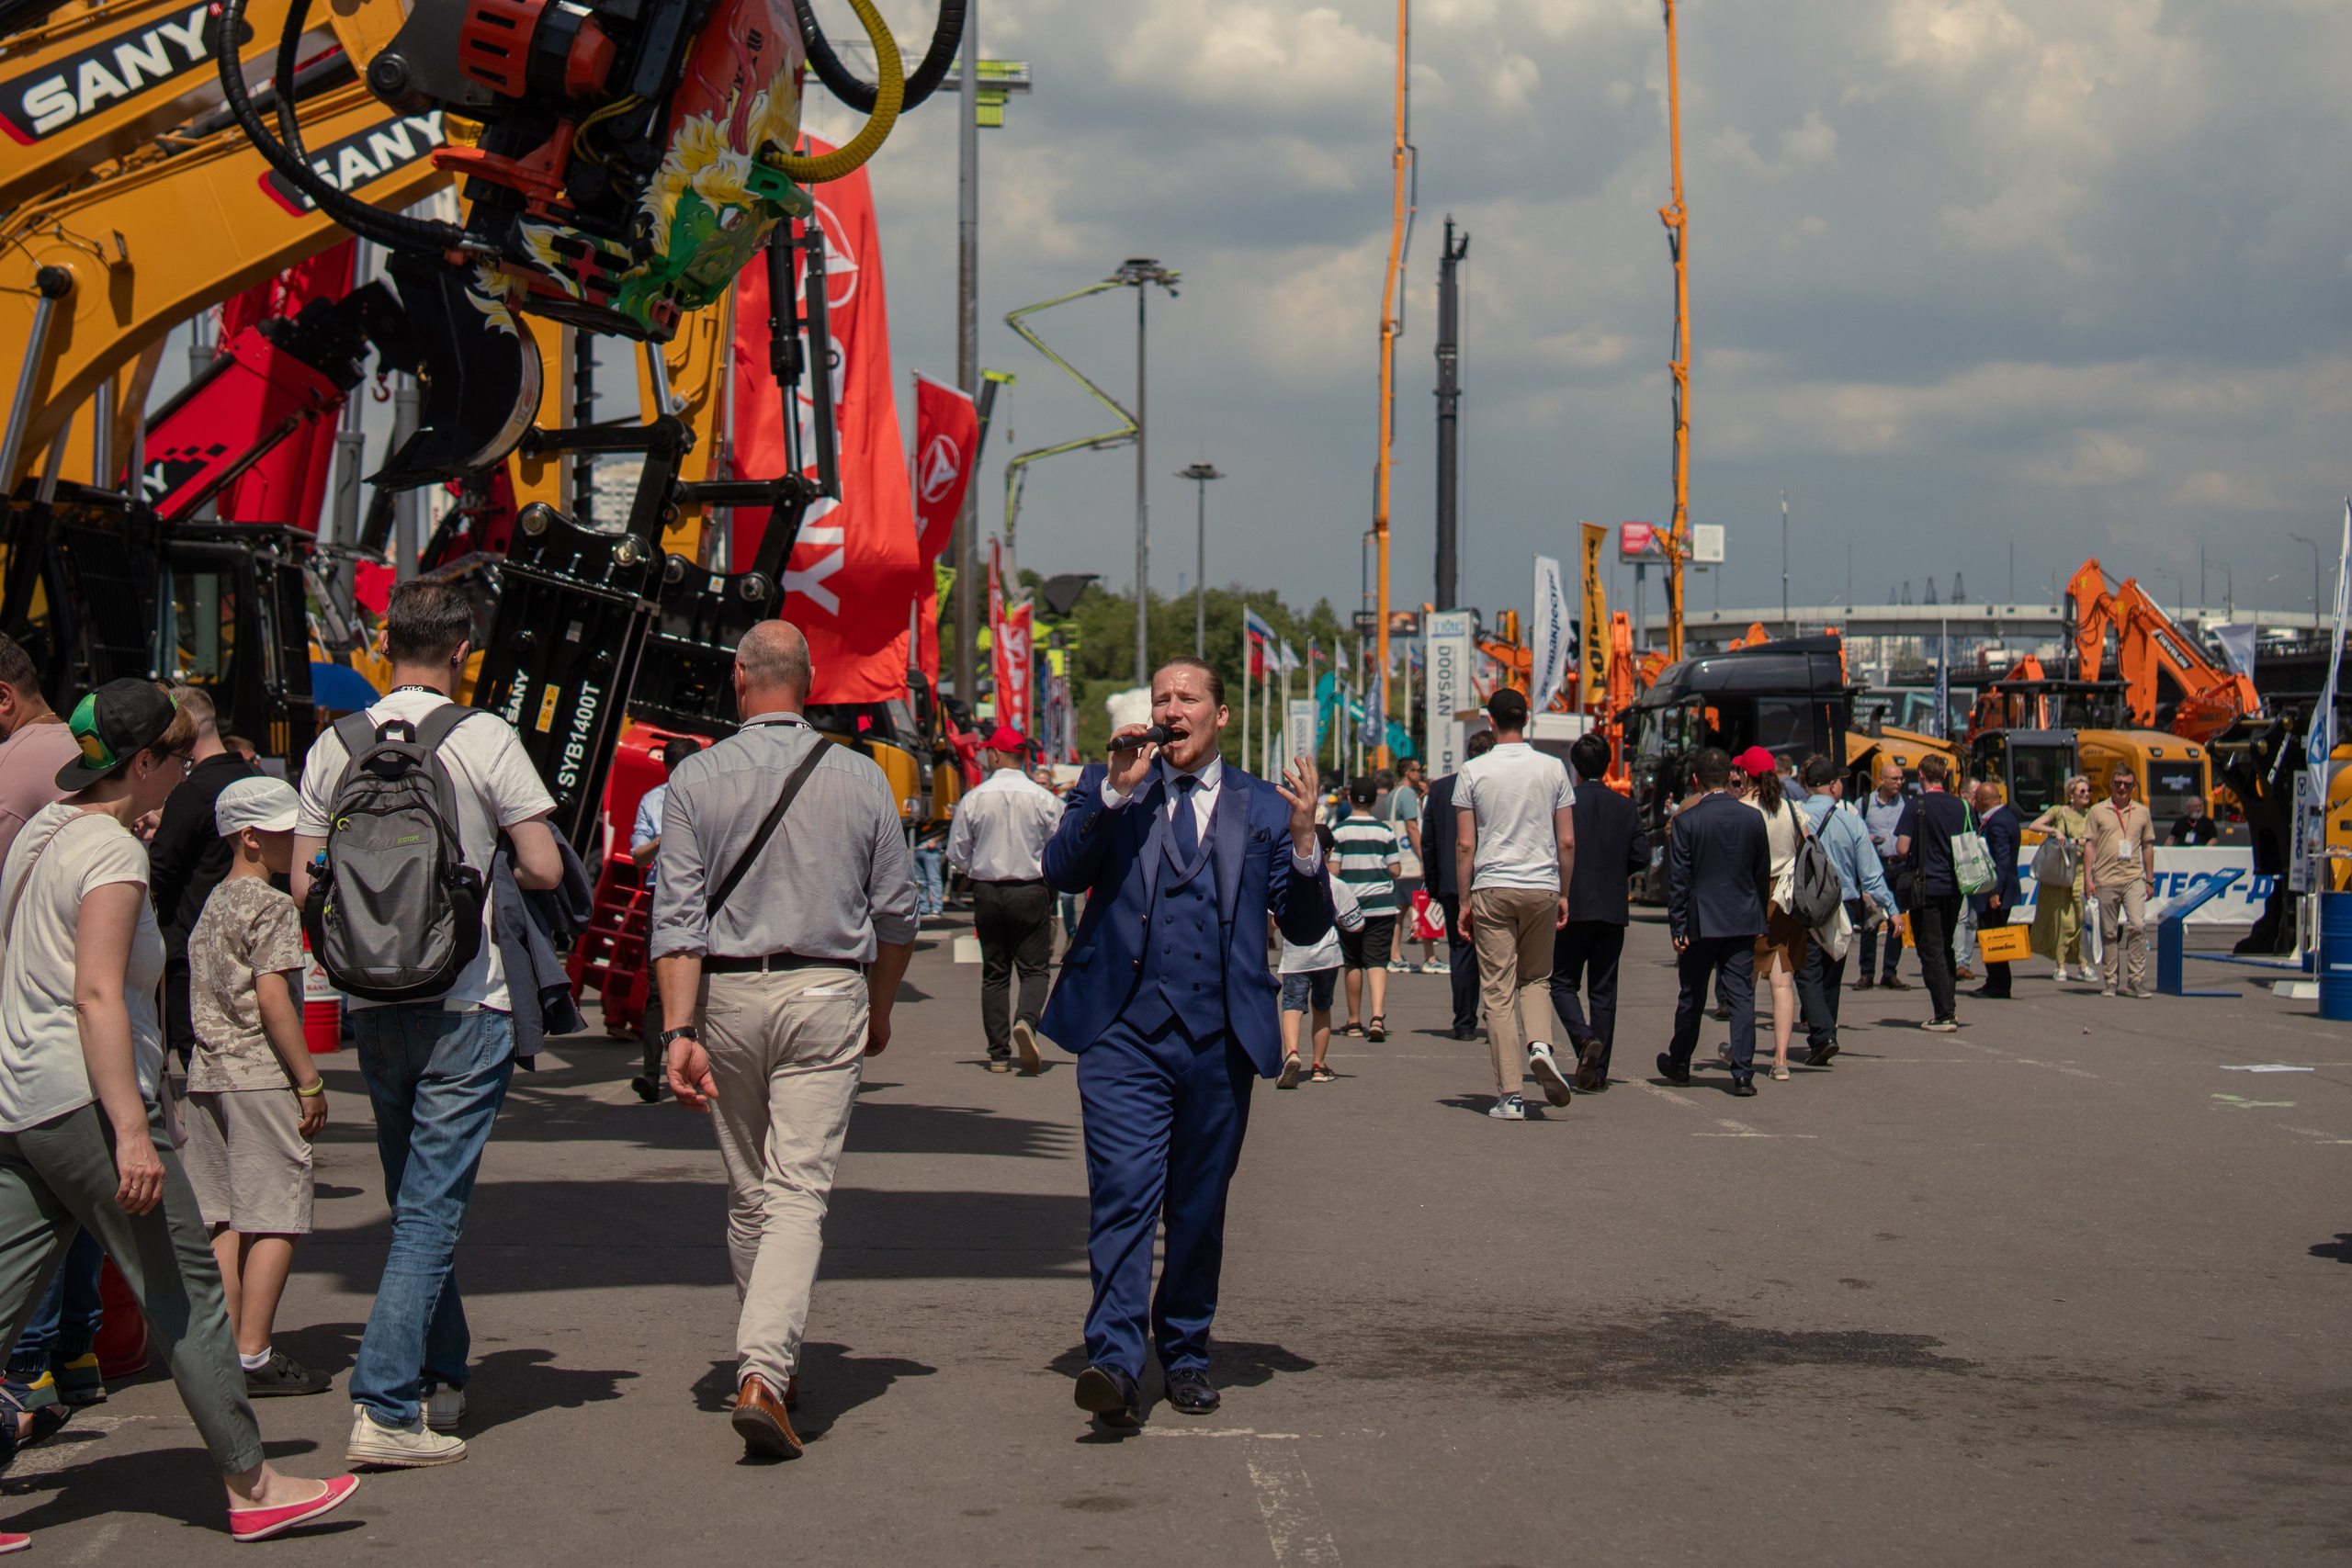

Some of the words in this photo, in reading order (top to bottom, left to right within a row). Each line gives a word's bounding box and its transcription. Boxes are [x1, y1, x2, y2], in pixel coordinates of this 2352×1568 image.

[22, 6, 210, 135] SANY
[1437, 645, 1451, 716] DOOSAN
[2157, 634, 2188, 670] DEVELON
[505, 668, 530, 724] SANY
[558, 680, 600, 787] SYB1400T
[397, 834, 420, 844] ECOTOPE
[2295, 799, 2306, 860] XCMG
